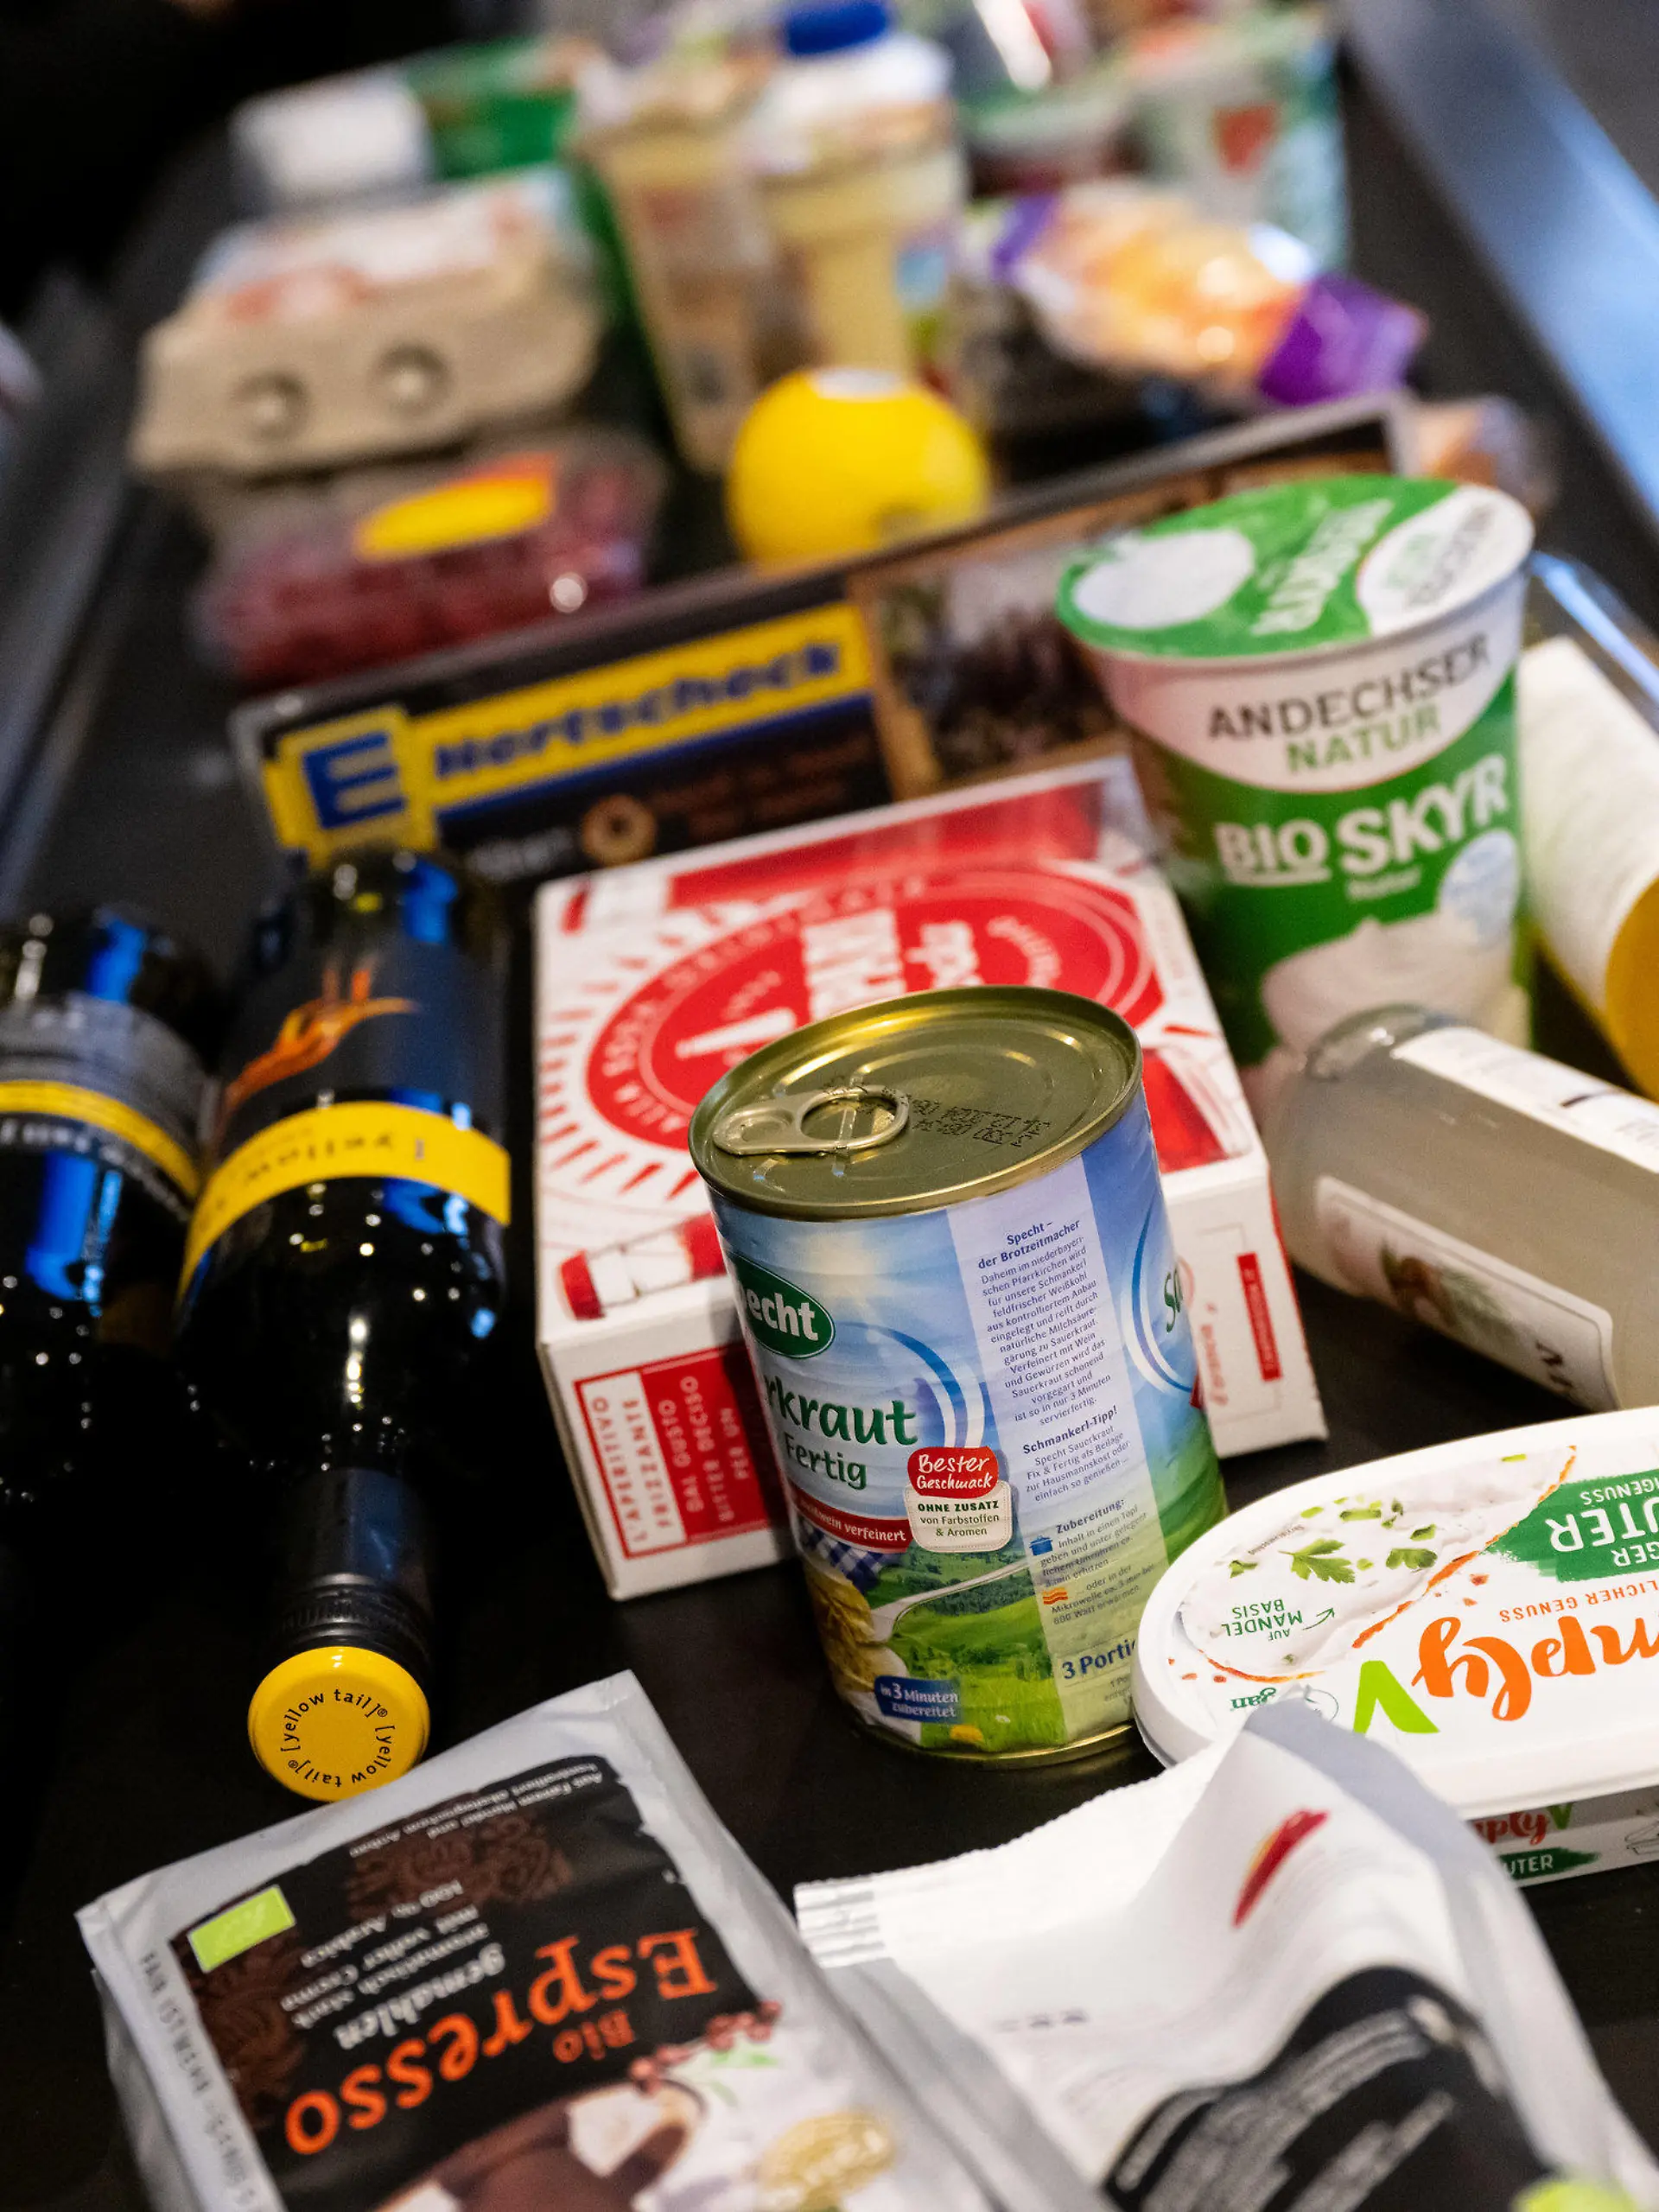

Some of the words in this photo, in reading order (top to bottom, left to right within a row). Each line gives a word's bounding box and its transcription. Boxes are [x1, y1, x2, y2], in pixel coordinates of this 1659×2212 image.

[1206, 632, 1489, 741] ANDECHSER
[1284, 703, 1442, 773] NATUR
[1214, 817, 1330, 876] BIO
[1336, 753, 1510, 875] SKYR
[978, 1256, 998, 1269] der
[1001, 1220, 1080, 1262] Brotzeitmacher
[1007, 1223, 1045, 1245] Specht
[982, 1282, 1010, 1297] schen
[1012, 1259, 1068, 1287] Pfarrkirchen
[1069, 1246, 1087, 1262] wird
[982, 1268, 1018, 1284] Daheim
[1018, 1262, 1030, 1271] im
[988, 1295, 1002, 1307] für
[1005, 1287, 1036, 1302] unsere
[1038, 1258, 1087, 1289] Schmankerl
[987, 1322, 1004, 1332] aus
[1005, 1294, 1071, 1326] kontrolliertem
[1071, 1280, 1097, 1298] Anbau
[993, 1293, 1047, 1318] feldfrischer
[1048, 1271, 1088, 1296] Weißkohl
[990, 1324, 1035, 1344] eingelegt
[1037, 1314, 1053, 1328] und
[1055, 1305, 1074, 1319] reift
[1075, 1292, 1099, 1309] durch
[1000, 1332, 1046, 1353] natürliche
[1004, 1348, 1038, 1366] gärung
[1039, 1344, 1049, 1352] zu
[1009, 1351, 1058, 1374] Verfeinert
[1059, 1344, 1073, 1357] mit
[1074, 1332, 1096, 1348] Wein
[1004, 1376, 1023, 1389] und
[1025, 1357, 1071, 1382] Gewürzen
[1071, 1347, 1090, 1363] wird
[1091, 1338, 1106, 1352] das
[1012, 1373, 1063, 1399] Sauerkraut
[1064, 1351, 1104, 1379] schonend
[1014, 1410, 1027, 1422] ist
[1028, 1408, 1040, 1417] so
[1042, 1402, 1052, 1413] in
[1052, 1397, 1069, 1408] nur
[1070, 1391, 1077, 1401] 3
[1077, 1374, 1112, 1397] Minuten
[1031, 1382, 1076, 1404] vorgegart
[1077, 1371, 1093, 1384] und
[1023, 1405, 1118, 1454] Schmankerl-Tipp!
[1039, 1395, 1097, 1426] servierfertig.
[784, 1433, 868, 1491] Fertig
[918, 1453, 990, 1474] Bester
[1027, 1471, 1041, 1481] Fix
[1043, 1465, 1052, 1475] &
[1052, 1456, 1080, 1471] Fertig
[1081, 1448, 1094, 1459] als
[1095, 1432, 1124, 1453] Beilage
[1034, 1449, 1066, 1466] Specht
[1069, 1425, 1115, 1453] Sauerkraut
[917, 1471, 993, 1490] Geschmack
[1026, 1482, 1040, 1493] zur
[1042, 1451, 1111, 1487] Hausmannskost
[1112, 1440, 1131, 1456] oder
[1035, 1484, 1069, 1502] einfach
[1071, 1478, 1081, 1488] so
[1083, 1459, 1122, 1484] genießen
[918, 1503, 950, 1512] OHNE
[954, 1500, 999, 1512] ZUSATZ
[920, 1516, 938, 1525] von
[942, 1513, 1000, 1525] Farbstoffen
[1056, 1498, 1126, 1535] Zubereitung:
[844, 1523, 907, 1542] verfeinert
[936, 1528, 944, 1536] &
[947, 1527, 988, 1536] Aromen
[1058, 1534, 1084, 1548] Inhalt
[1086, 1528, 1096, 1538] in
[1040, 1550, 1069, 1567] geben
[1071, 1542, 1088, 1555] und
[1052, 1590, 1103, 1614] Mikrowelle
[1086, 1578, 1106, 1591] oder
[1587, 1580, 1659, 1606] LICHER
[1221, 1610, 1303, 1637] MANDEL
[1232, 1599, 1285, 1620] BASIS
[1498, 1596, 1579, 1624] GENUSS
[1268, 1628, 1290, 1642] AUF
[1062, 1661, 1076, 1680] 3
[1079, 1638, 1135, 1675] Porti
[892, 1681, 903, 1700] 3
[904, 1689, 959, 1703] Minuten
[334, 1942, 505, 2050] gemahlen
[285, 1928, 717, 2155] Espresso
[553, 2009, 635, 2064] Bio
